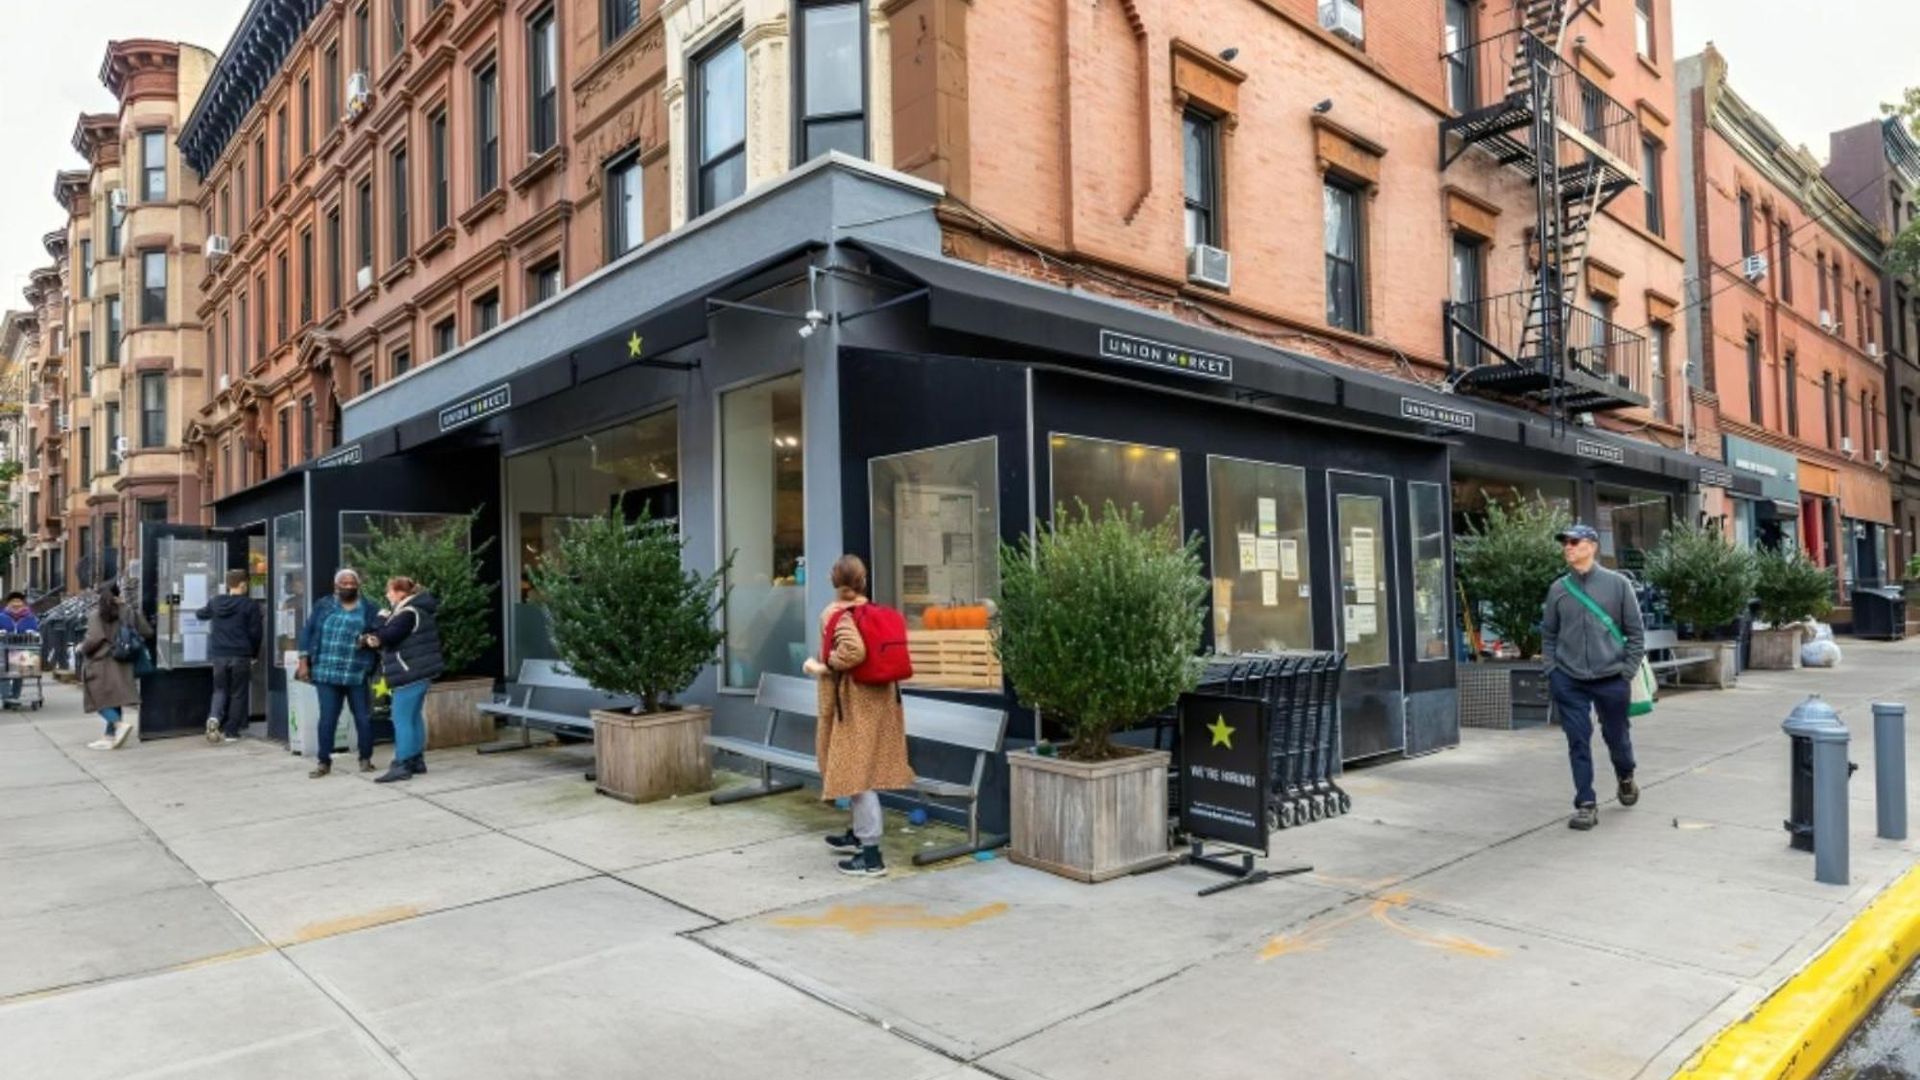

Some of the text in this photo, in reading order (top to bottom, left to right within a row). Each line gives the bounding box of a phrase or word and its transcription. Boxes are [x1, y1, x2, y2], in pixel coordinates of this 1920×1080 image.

[1109, 339, 1224, 373] UNION MRKET
[470, 391, 505, 414] MRKET
[1437, 410, 1470, 425] MRKET
